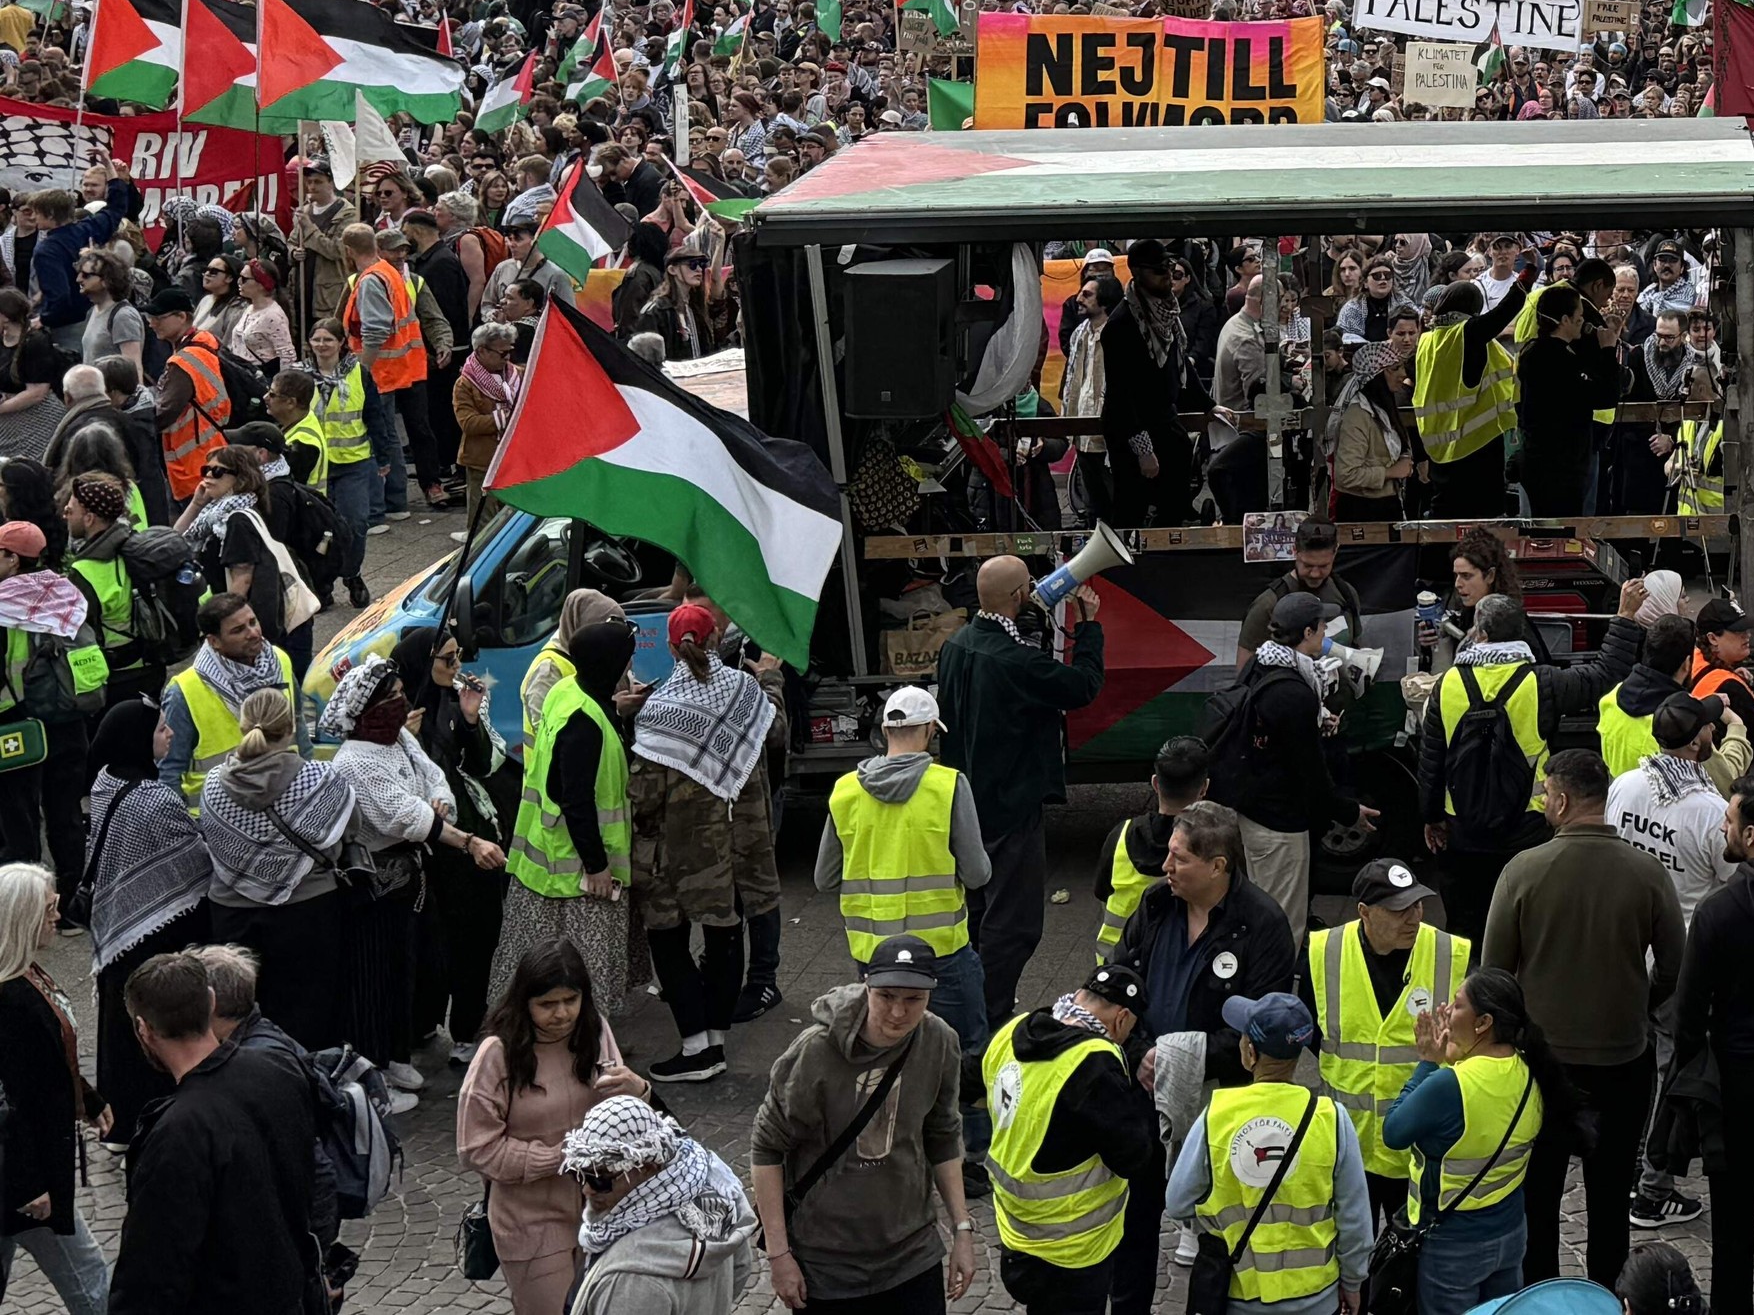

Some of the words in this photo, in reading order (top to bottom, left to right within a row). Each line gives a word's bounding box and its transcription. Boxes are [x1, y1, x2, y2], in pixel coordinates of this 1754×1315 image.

[1026, 32, 1156, 97] NEJ
[1163, 35, 1297, 101] TILL
[1417, 46, 1469, 62] KLIMATET
[1415, 72, 1469, 90] PALESTINA
[129, 130, 208, 181] RIV
[1621, 811, 1677, 847] FUCK
[1231, 1125, 1253, 1156] LATINOS
